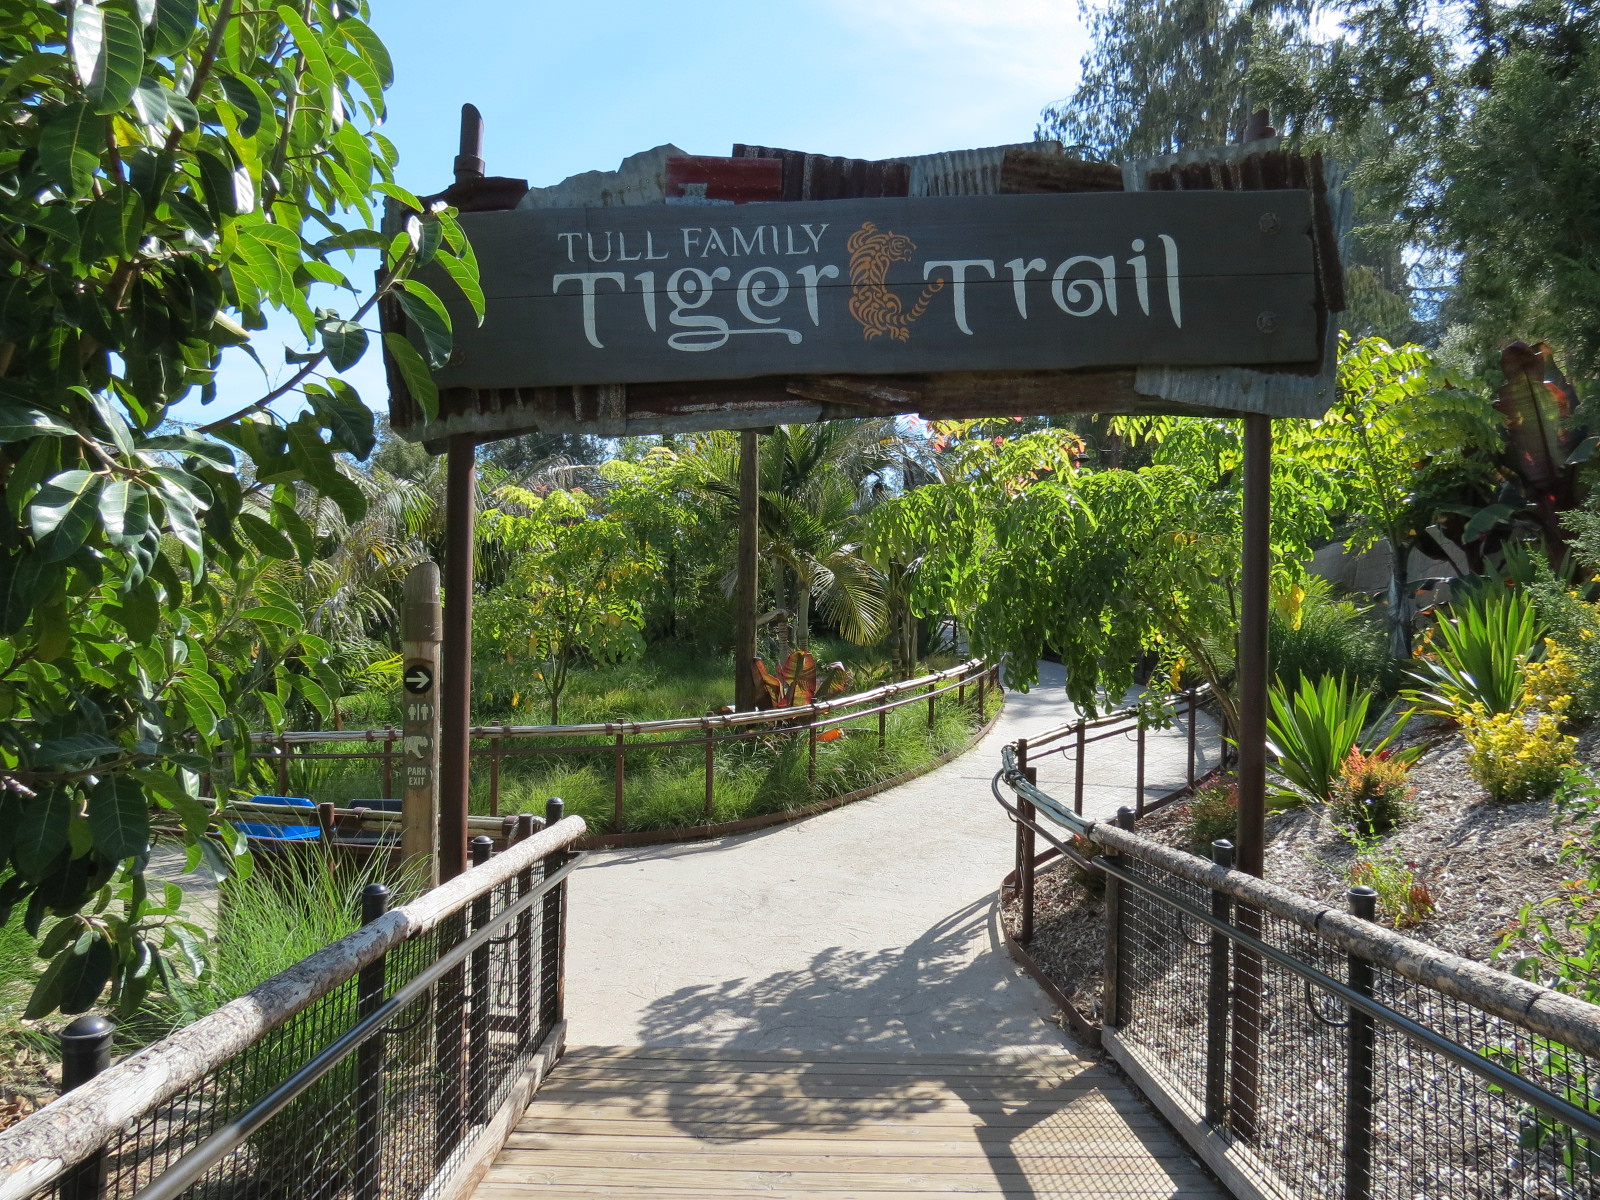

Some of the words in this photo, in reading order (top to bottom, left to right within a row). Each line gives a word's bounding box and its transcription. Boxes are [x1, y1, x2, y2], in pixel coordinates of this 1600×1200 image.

[557, 229, 670, 262] TULL
[681, 222, 830, 258] FAMILY
[552, 263, 840, 353] Tiger
[923, 233, 1182, 336] Trail
[408, 766, 426, 775] PARK
[409, 777, 424, 785] EXIT
